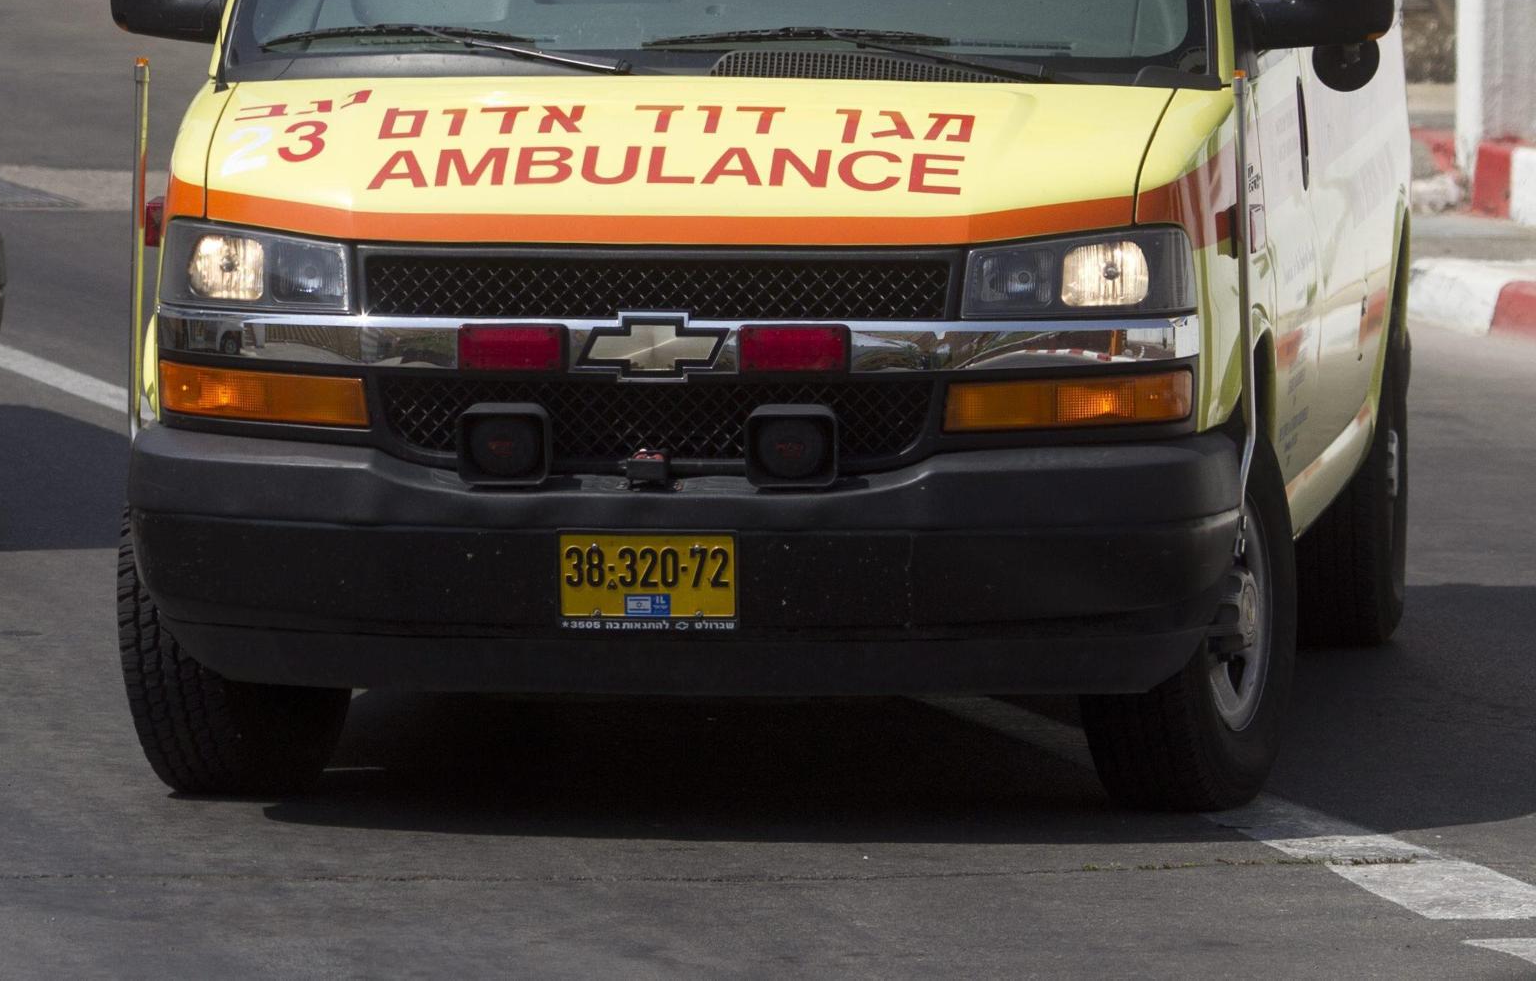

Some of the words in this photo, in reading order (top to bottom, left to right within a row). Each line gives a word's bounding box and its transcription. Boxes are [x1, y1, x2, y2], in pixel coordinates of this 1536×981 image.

[377, 104, 586, 140] אדום
[634, 104, 787, 135] דוד
[835, 108, 976, 144] מגן
[366, 145, 966, 196] AMBULANCE
